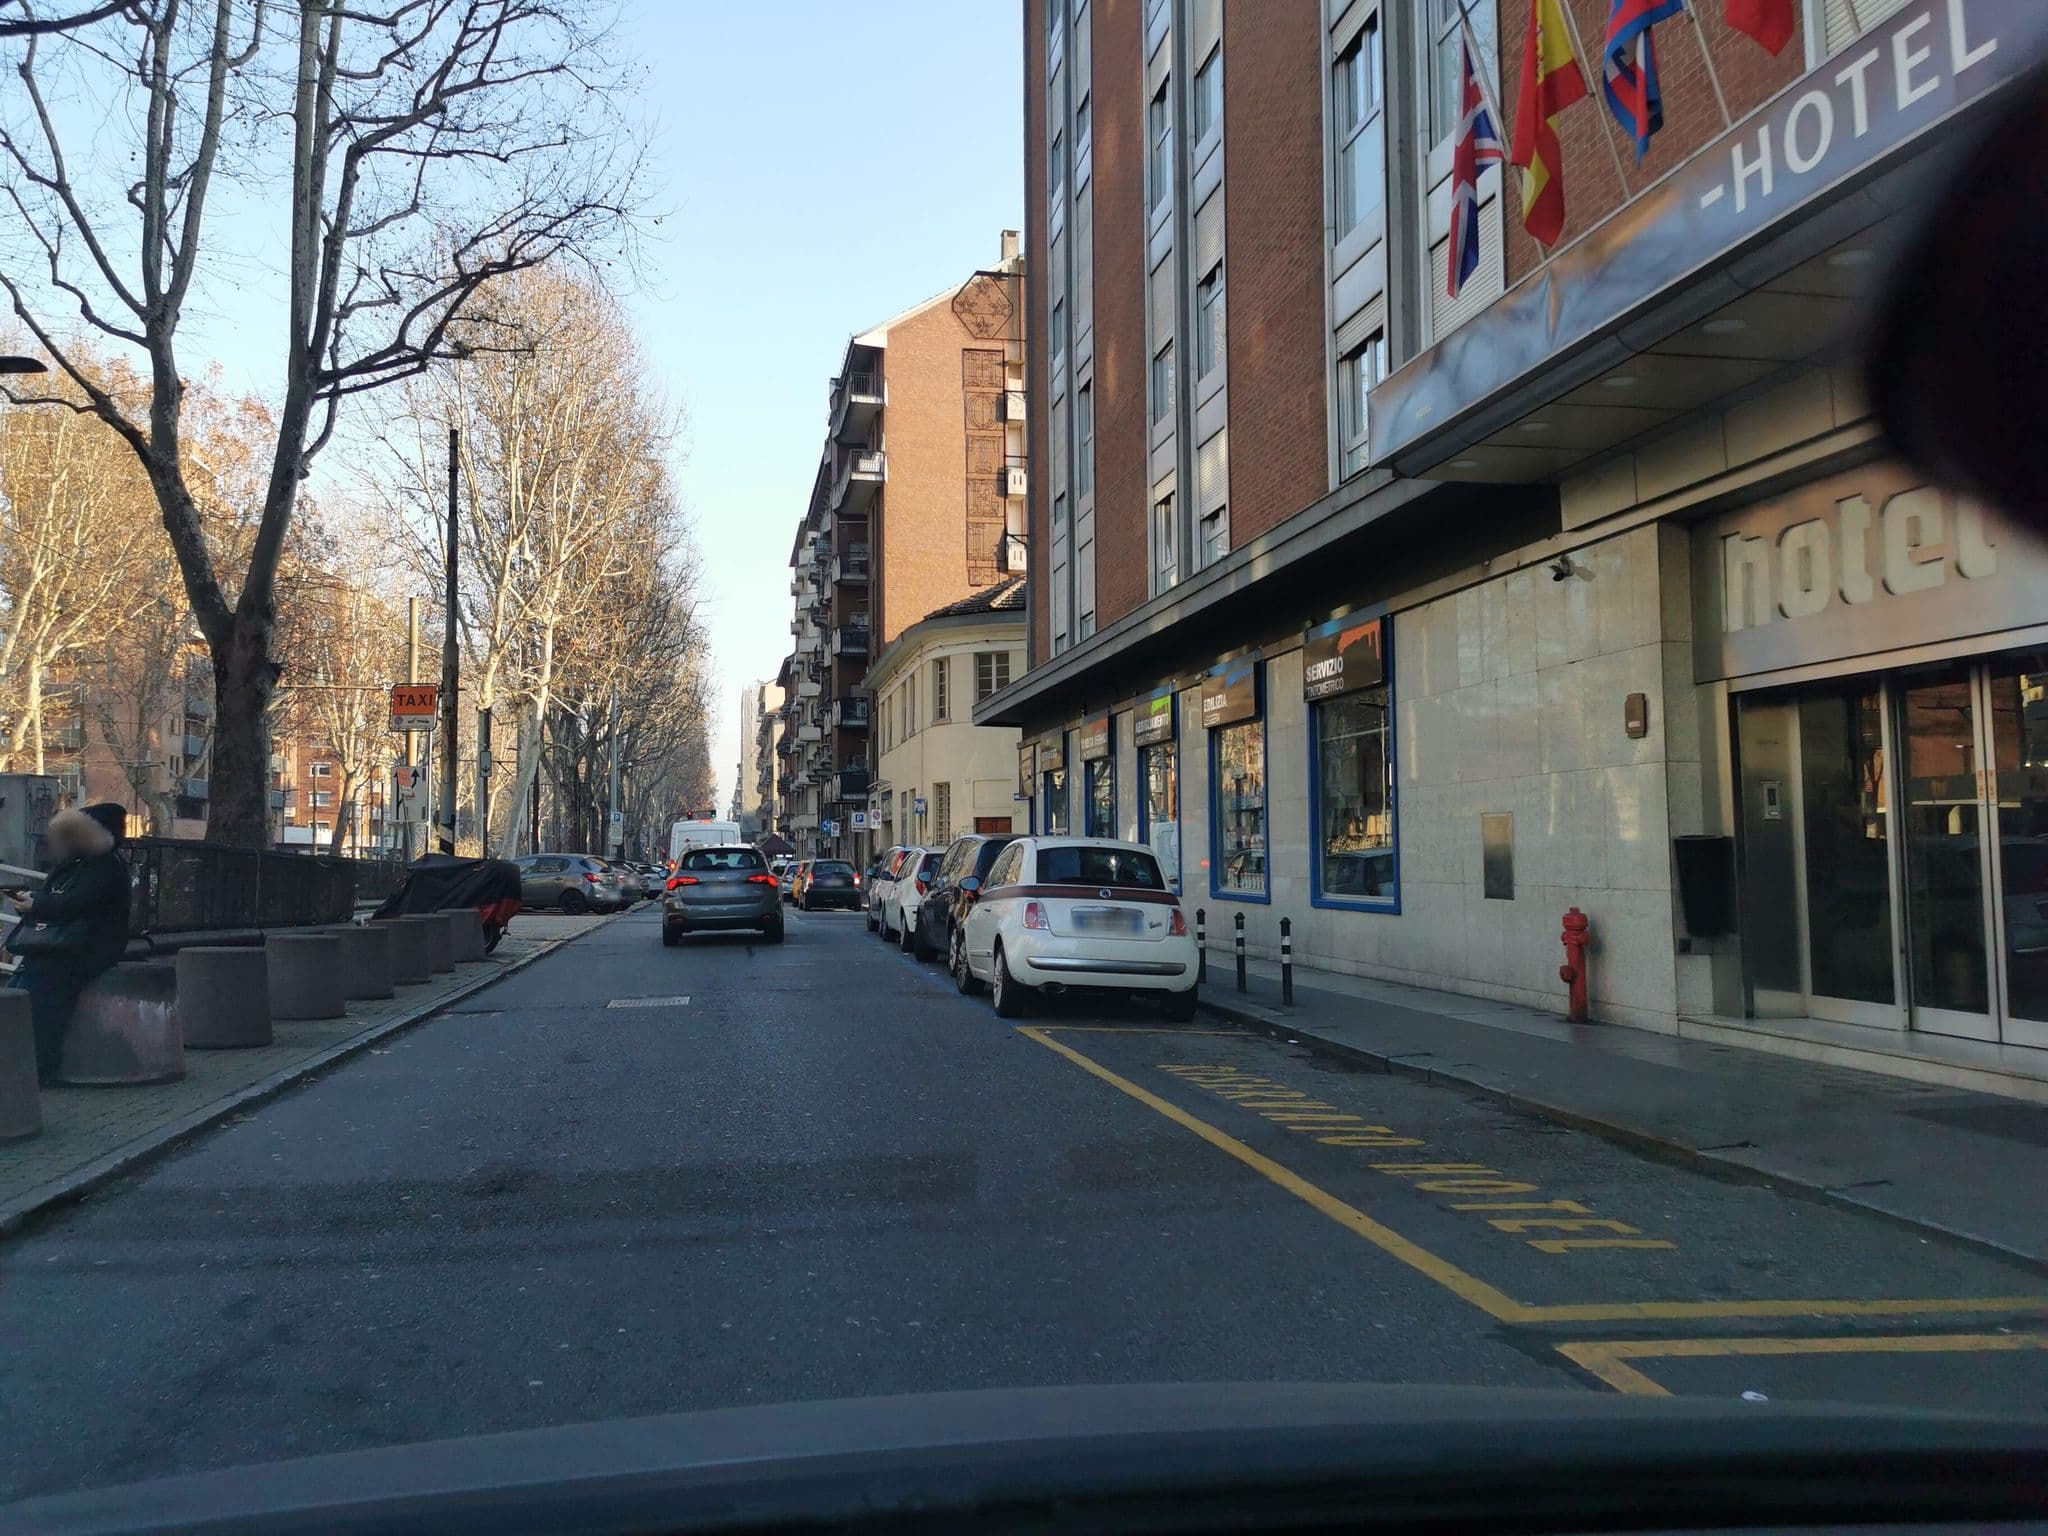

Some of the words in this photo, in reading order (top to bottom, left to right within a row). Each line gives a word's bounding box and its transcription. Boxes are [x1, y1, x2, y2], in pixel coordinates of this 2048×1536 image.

[1306, 656, 1344, 682] SERVIZIO
[397, 694, 433, 706] TAXI
[1368, 1163, 1678, 1254] HOTEL
